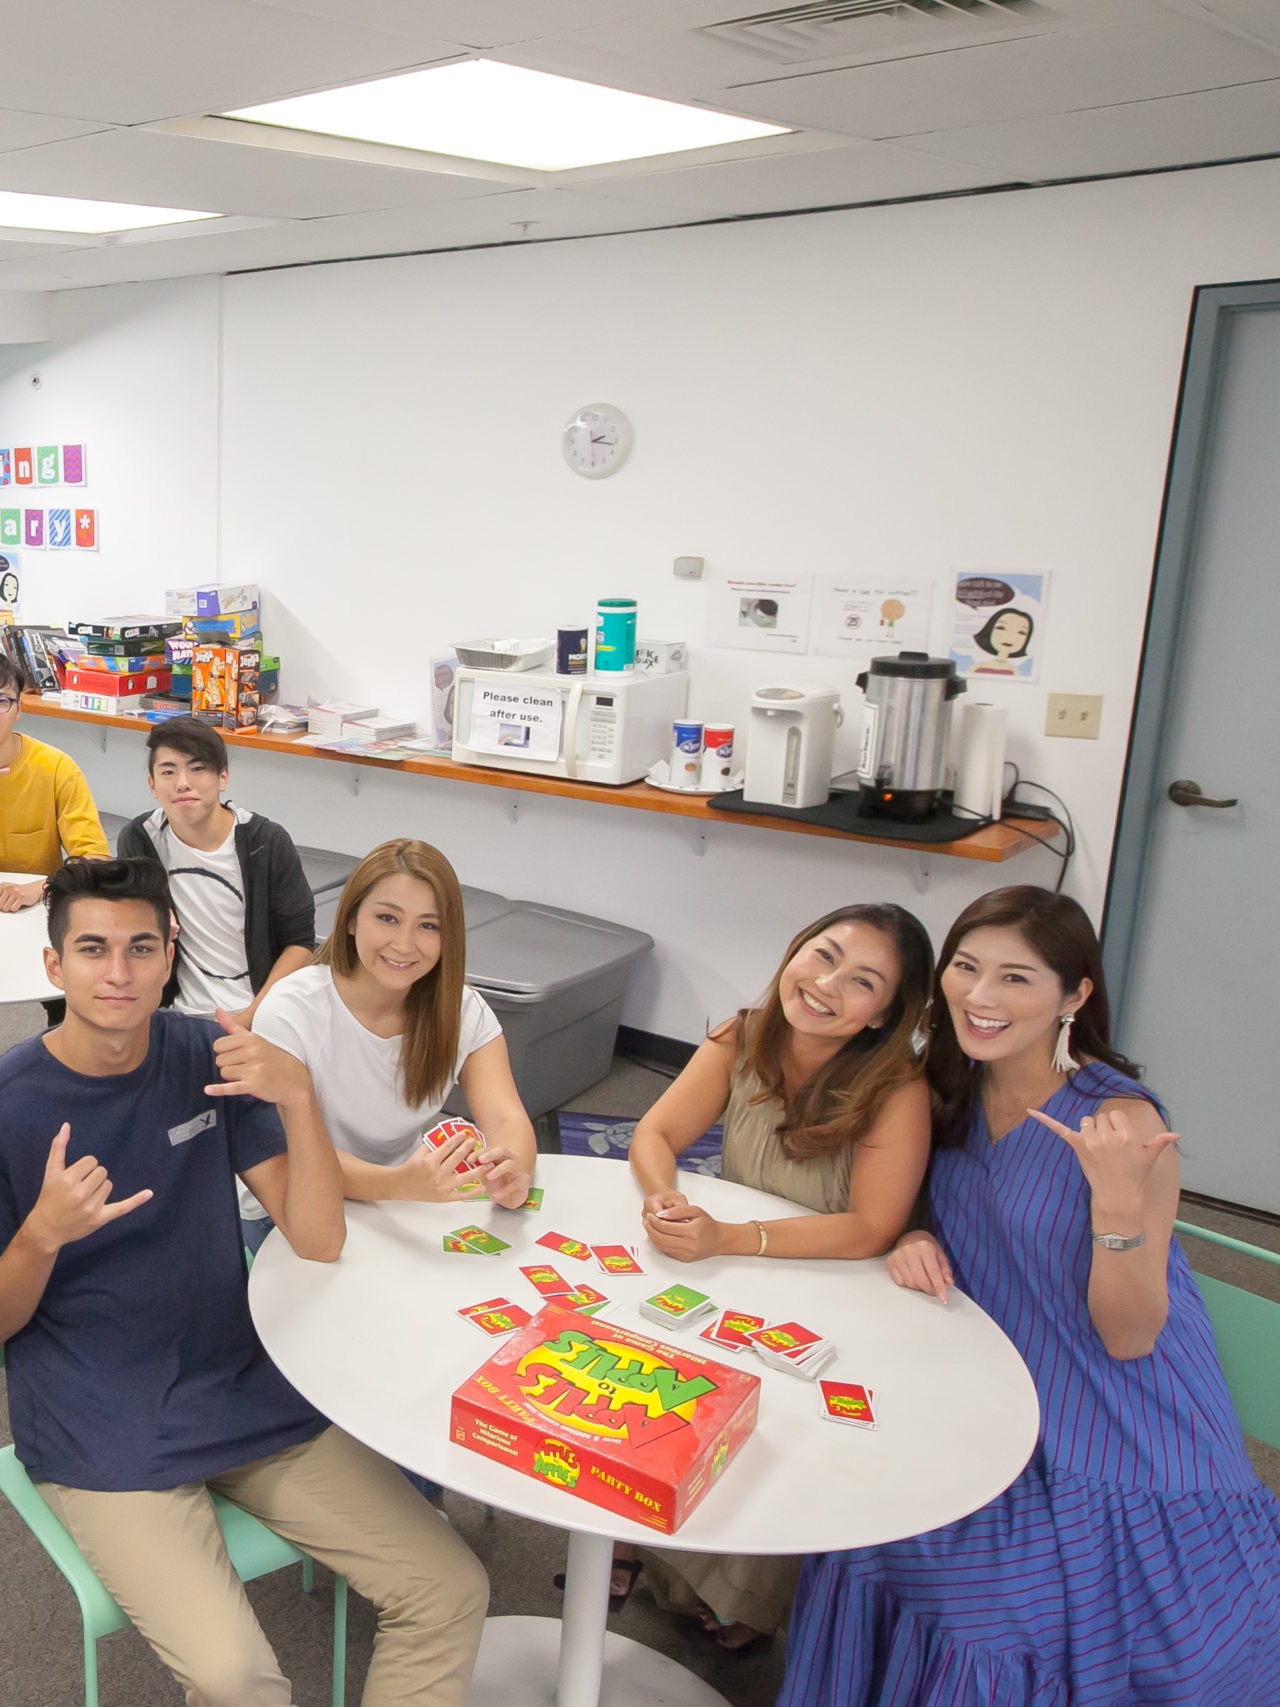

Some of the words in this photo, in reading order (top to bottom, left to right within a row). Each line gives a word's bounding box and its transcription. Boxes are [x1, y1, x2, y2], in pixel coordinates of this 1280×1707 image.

[483, 691, 519, 703] Please
[523, 695, 553, 707] clean
[489, 709, 516, 719] after
[520, 714, 543, 723] use.
[625, 1338, 652, 1352] Game
[660, 1347, 707, 1365] Hilarious
[598, 1381, 616, 1396] to
[496, 1391, 536, 1423] PARTY
[475, 1418, 488, 1429] The
[488, 1422, 509, 1438] Game
[480, 1428, 511, 1446] Hilarious
[589, 1465, 633, 1495] PARTY
[634, 1490, 662, 1513] BOX
